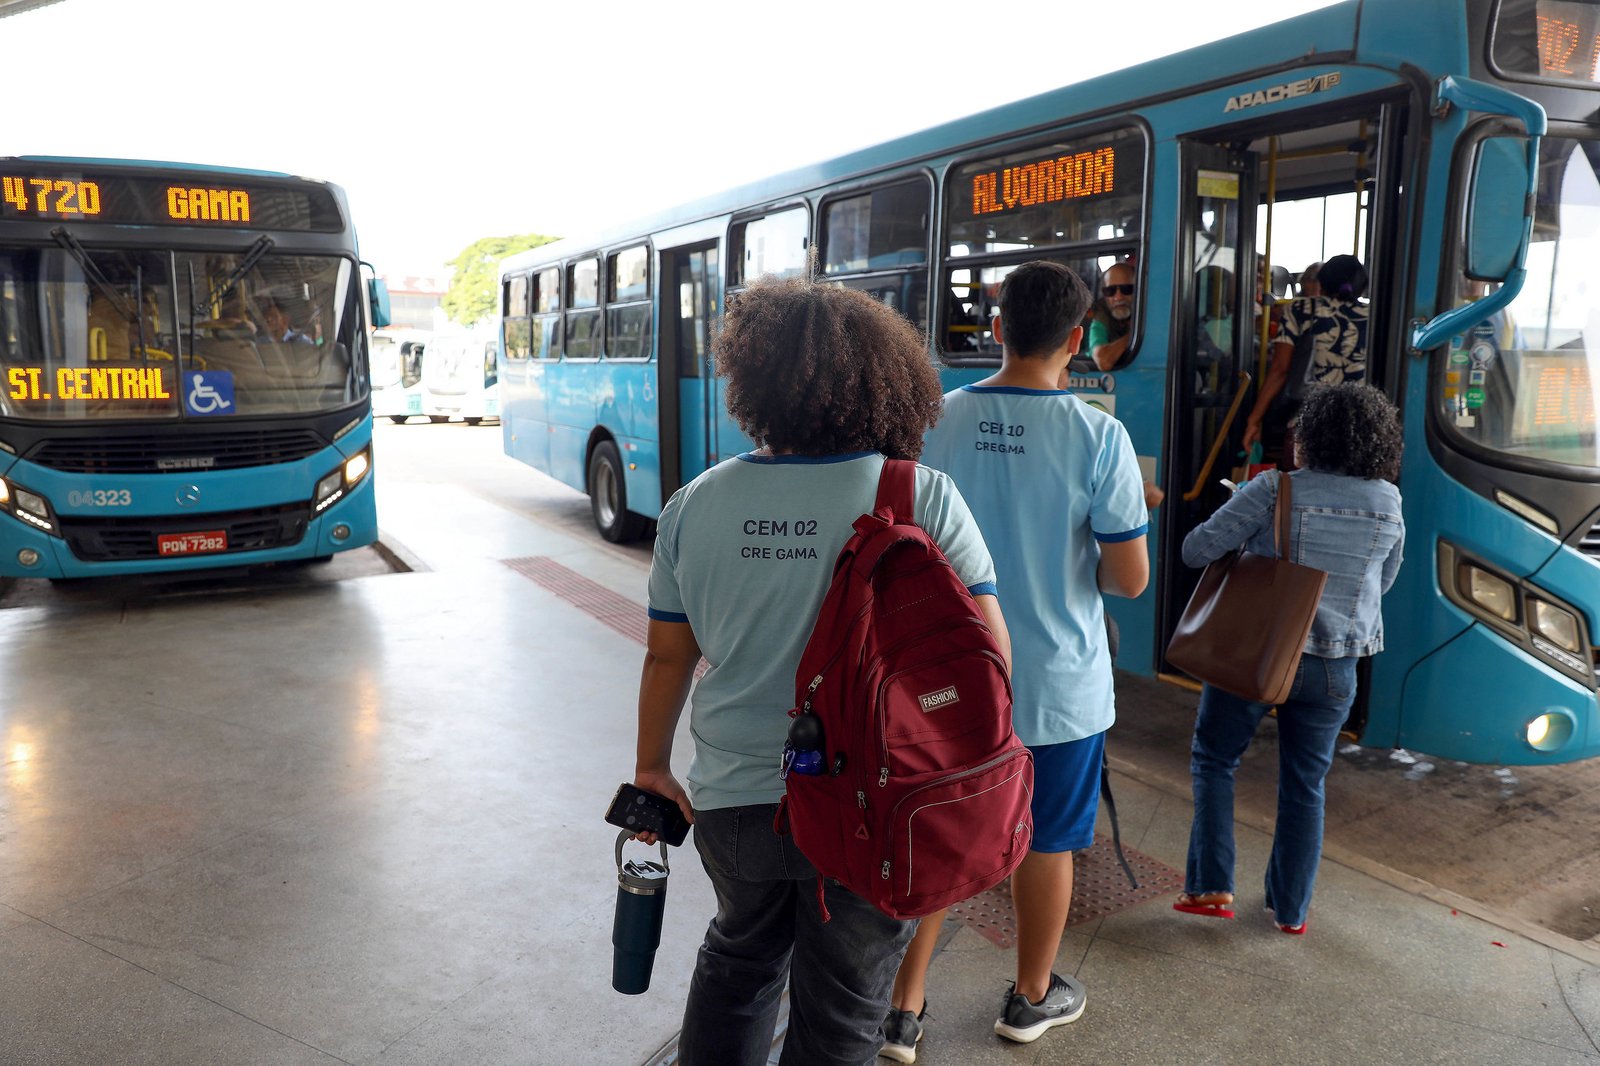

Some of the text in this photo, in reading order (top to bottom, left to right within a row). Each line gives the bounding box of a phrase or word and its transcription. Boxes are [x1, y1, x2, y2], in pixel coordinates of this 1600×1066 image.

[973, 147, 1115, 215] ALVORADA
[3, 177, 250, 222] 4720 GAMA
[8, 367, 51, 399] ST.
[1006, 424, 1025, 437] 10
[68, 489, 132, 507] 04323
[743, 519, 818, 536] CEM 02
[741, 546, 818, 560] CRE GAMA
[922, 689, 956, 708] FASHION
